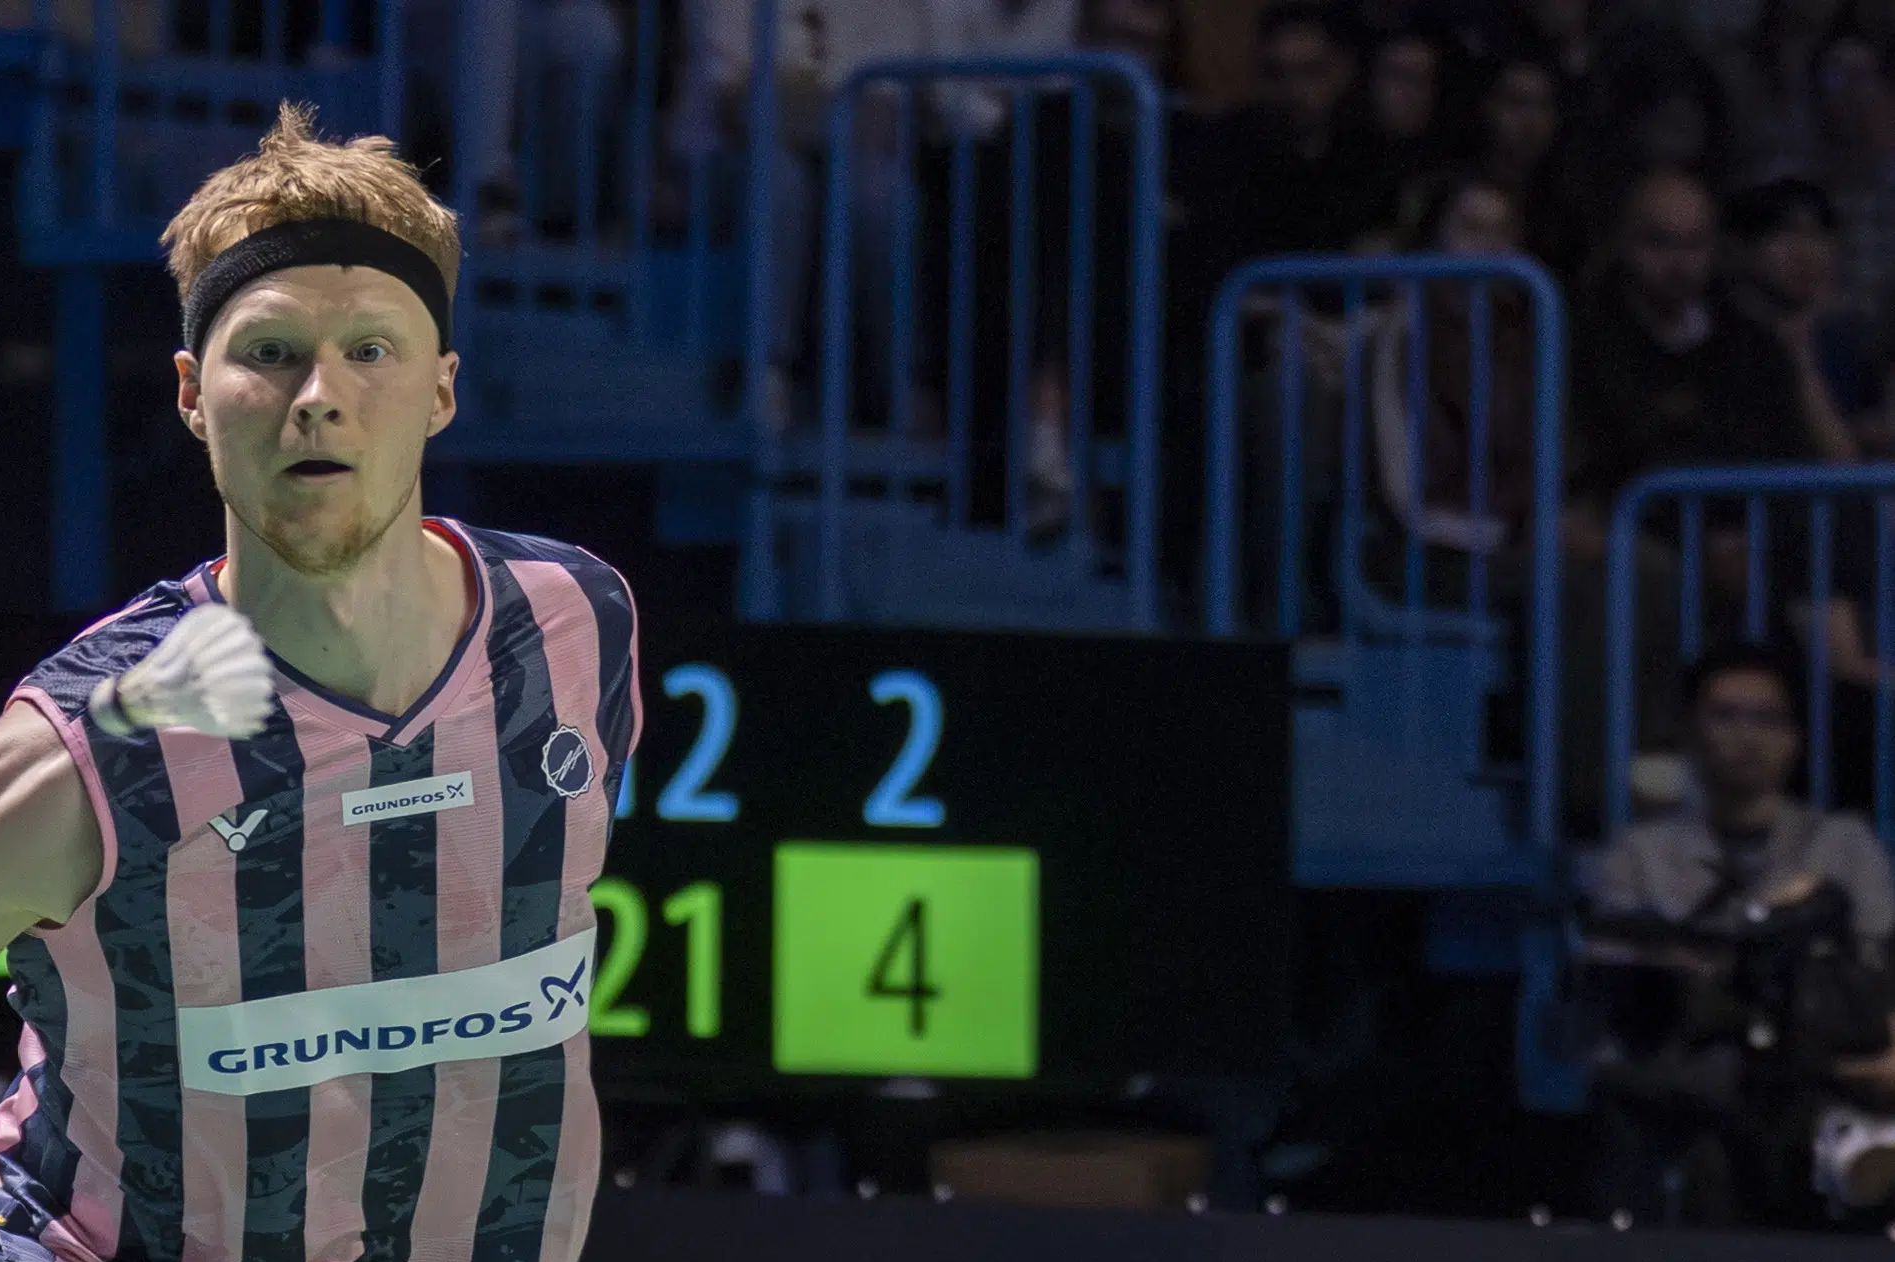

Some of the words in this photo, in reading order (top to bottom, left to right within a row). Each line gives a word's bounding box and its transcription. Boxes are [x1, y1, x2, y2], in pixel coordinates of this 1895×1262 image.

[351, 791, 445, 816] GRUNDFOS
[615, 664, 739, 821] 2
[863, 668, 946, 827] 2
[588, 877, 723, 1038] 21
[865, 895, 943, 1038] 4
[207, 1001, 533, 1074] GRUNDFOS
